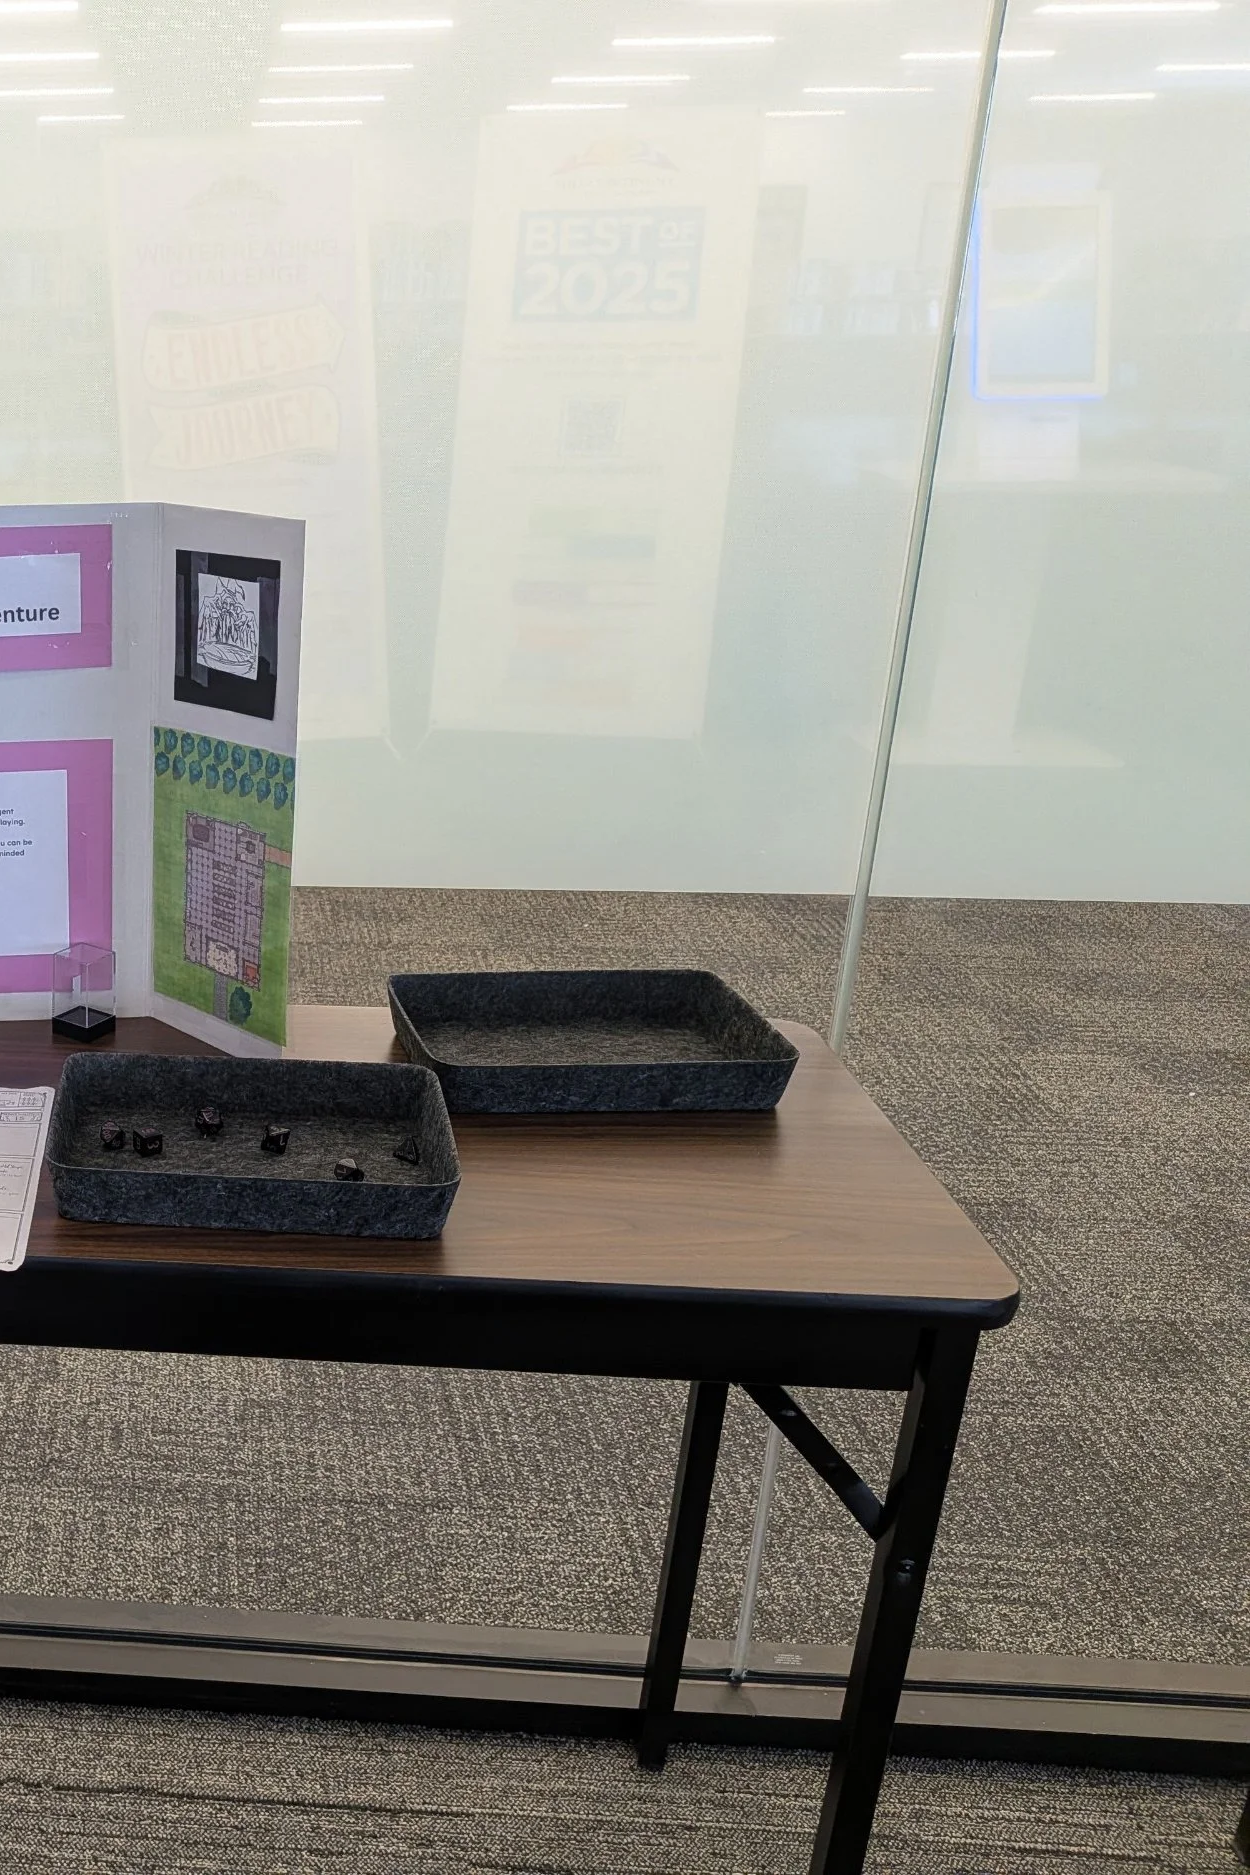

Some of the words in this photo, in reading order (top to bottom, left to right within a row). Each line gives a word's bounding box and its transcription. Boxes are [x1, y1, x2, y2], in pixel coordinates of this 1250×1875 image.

[525, 215, 653, 257] BEST
[658, 220, 697, 241] OF
[518, 259, 692, 317] 2025
[165, 314, 319, 386] ENDLESS
[175, 393, 317, 467] JOURNEY
[23, 838, 33, 846] be
